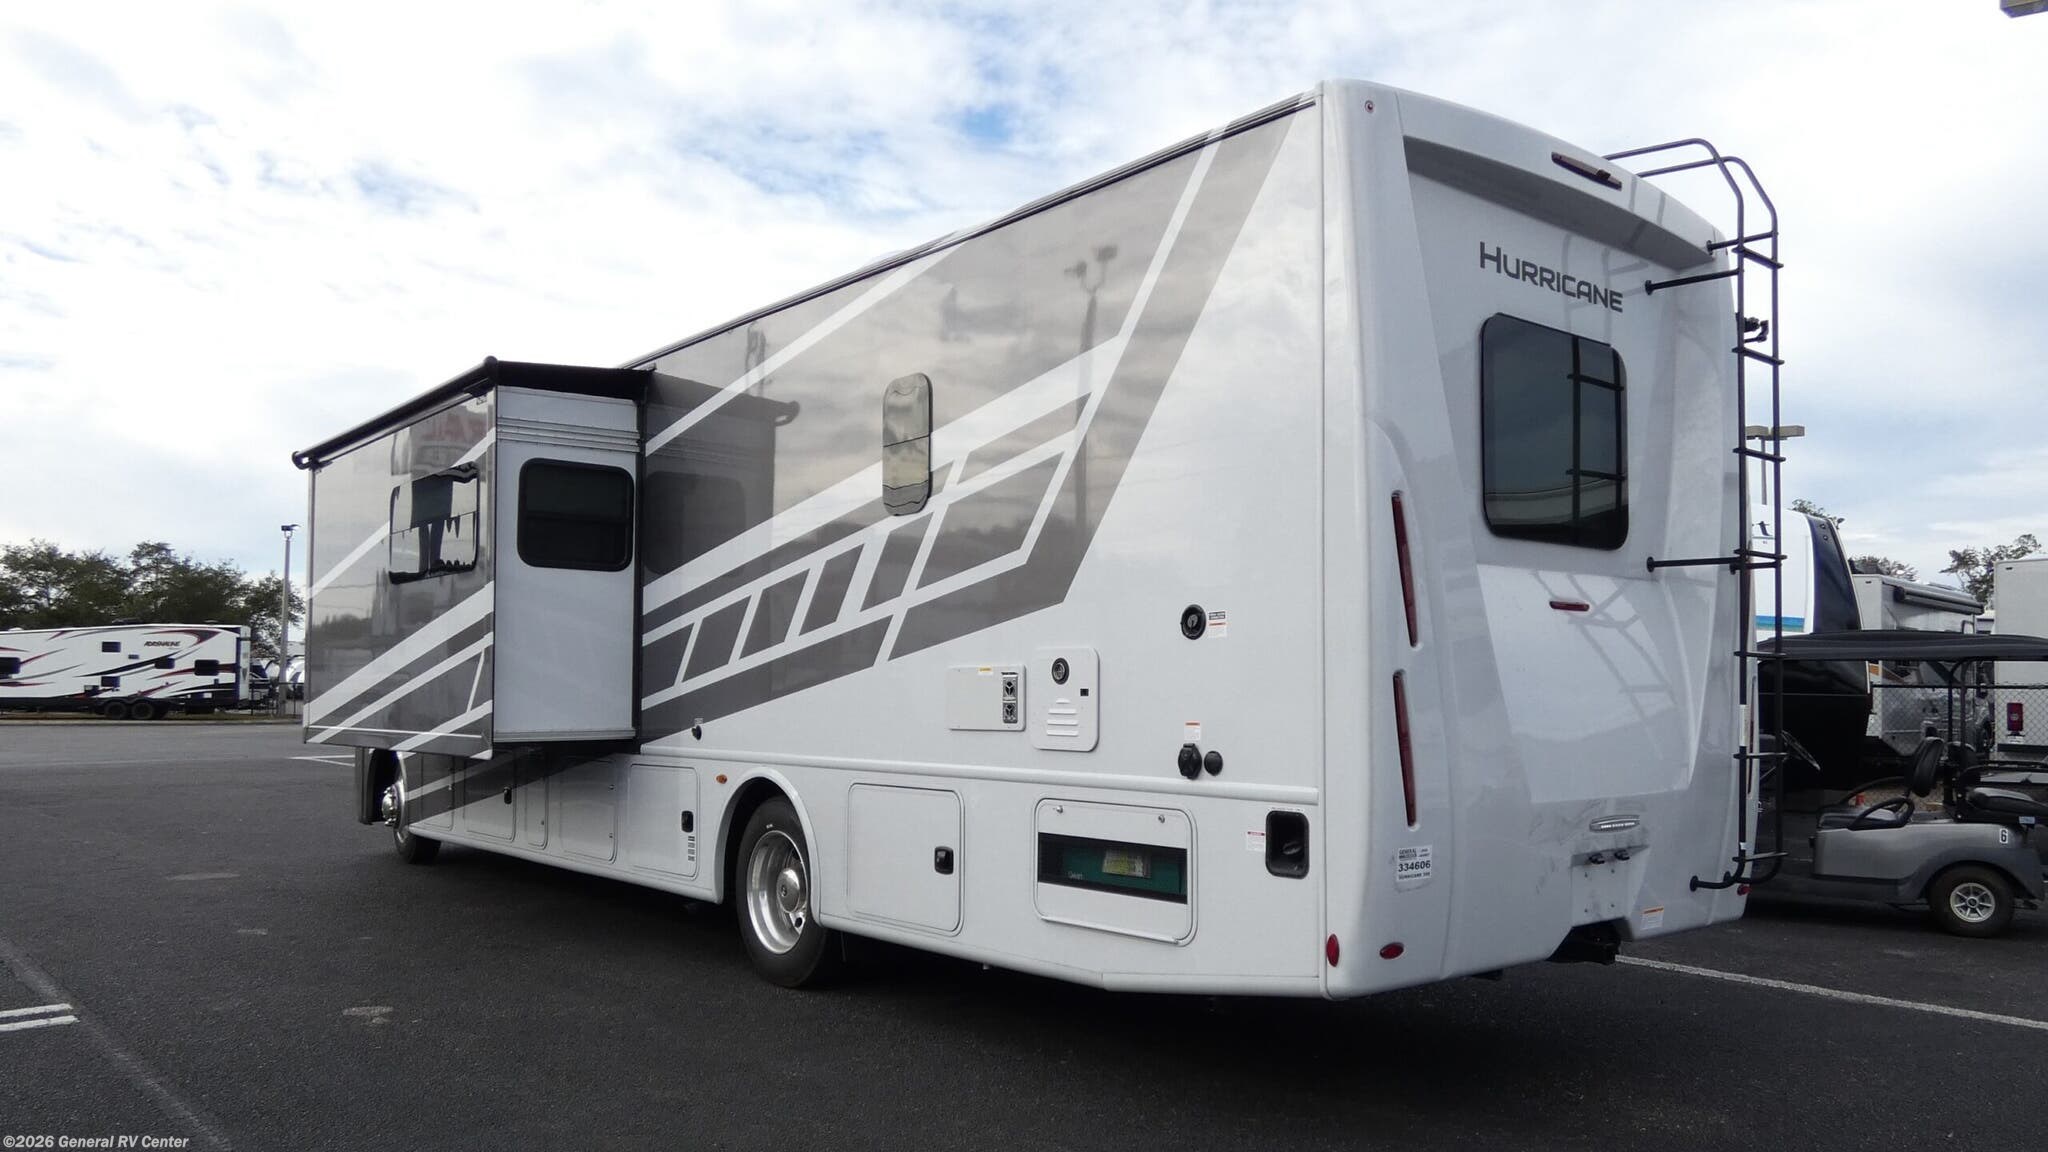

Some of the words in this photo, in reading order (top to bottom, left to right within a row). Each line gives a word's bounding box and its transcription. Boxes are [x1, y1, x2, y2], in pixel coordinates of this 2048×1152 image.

[1479, 241, 1623, 313] HURRICANE
[2000, 829, 2008, 843] 6
[1398, 860, 1431, 873] 334606
